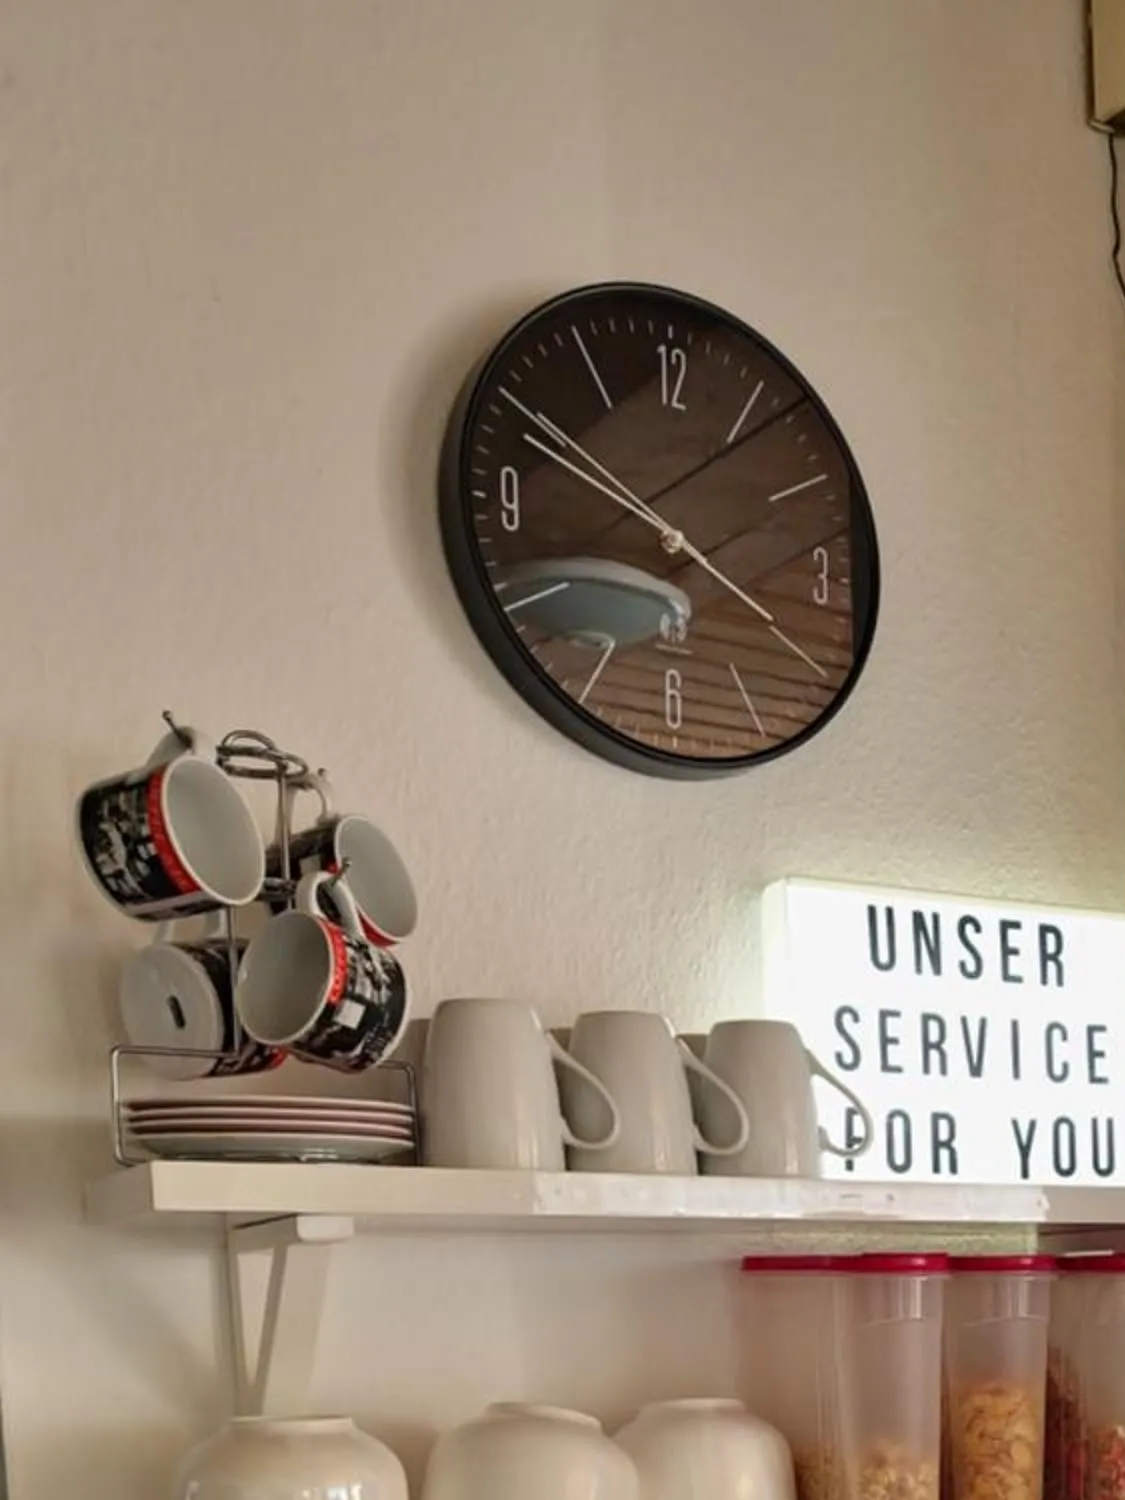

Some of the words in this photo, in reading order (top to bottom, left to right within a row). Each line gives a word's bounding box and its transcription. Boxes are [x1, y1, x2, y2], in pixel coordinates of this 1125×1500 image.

[657, 344, 687, 411] 12
[500, 465, 520, 532] 9
[811, 547, 830, 605] 3
[663, 668, 682, 729] 6
[866, 904, 1066, 988] UNSER
[833, 1004, 1111, 1086] SERVICE
[1010, 1116, 1117, 1180] YOU
